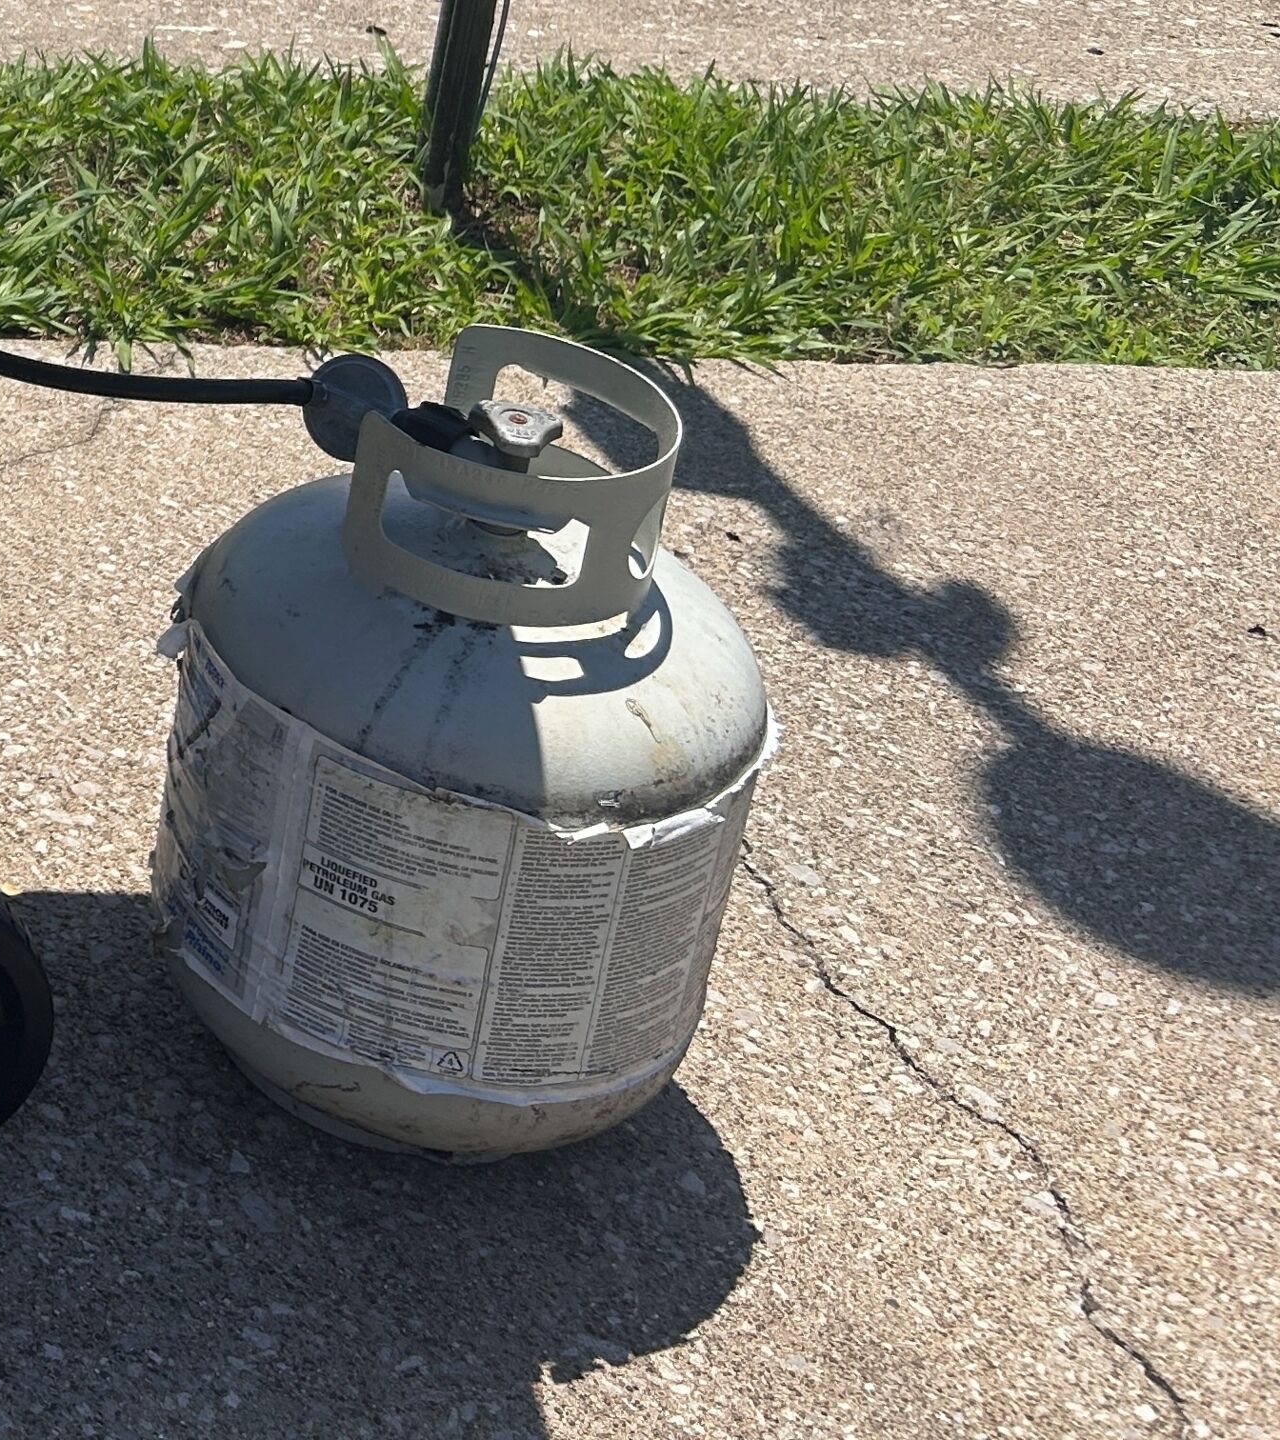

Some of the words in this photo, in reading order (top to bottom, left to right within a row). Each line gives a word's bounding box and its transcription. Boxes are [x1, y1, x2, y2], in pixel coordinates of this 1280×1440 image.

[303, 858, 368, 897] PETROLEUM
[371, 889, 396, 906] GAS
[320, 856, 378, 888] LIQUEFIED
[313, 874, 335, 896] UN
[340, 888, 379, 913] 1075
[185, 928, 222, 972] Rhino
